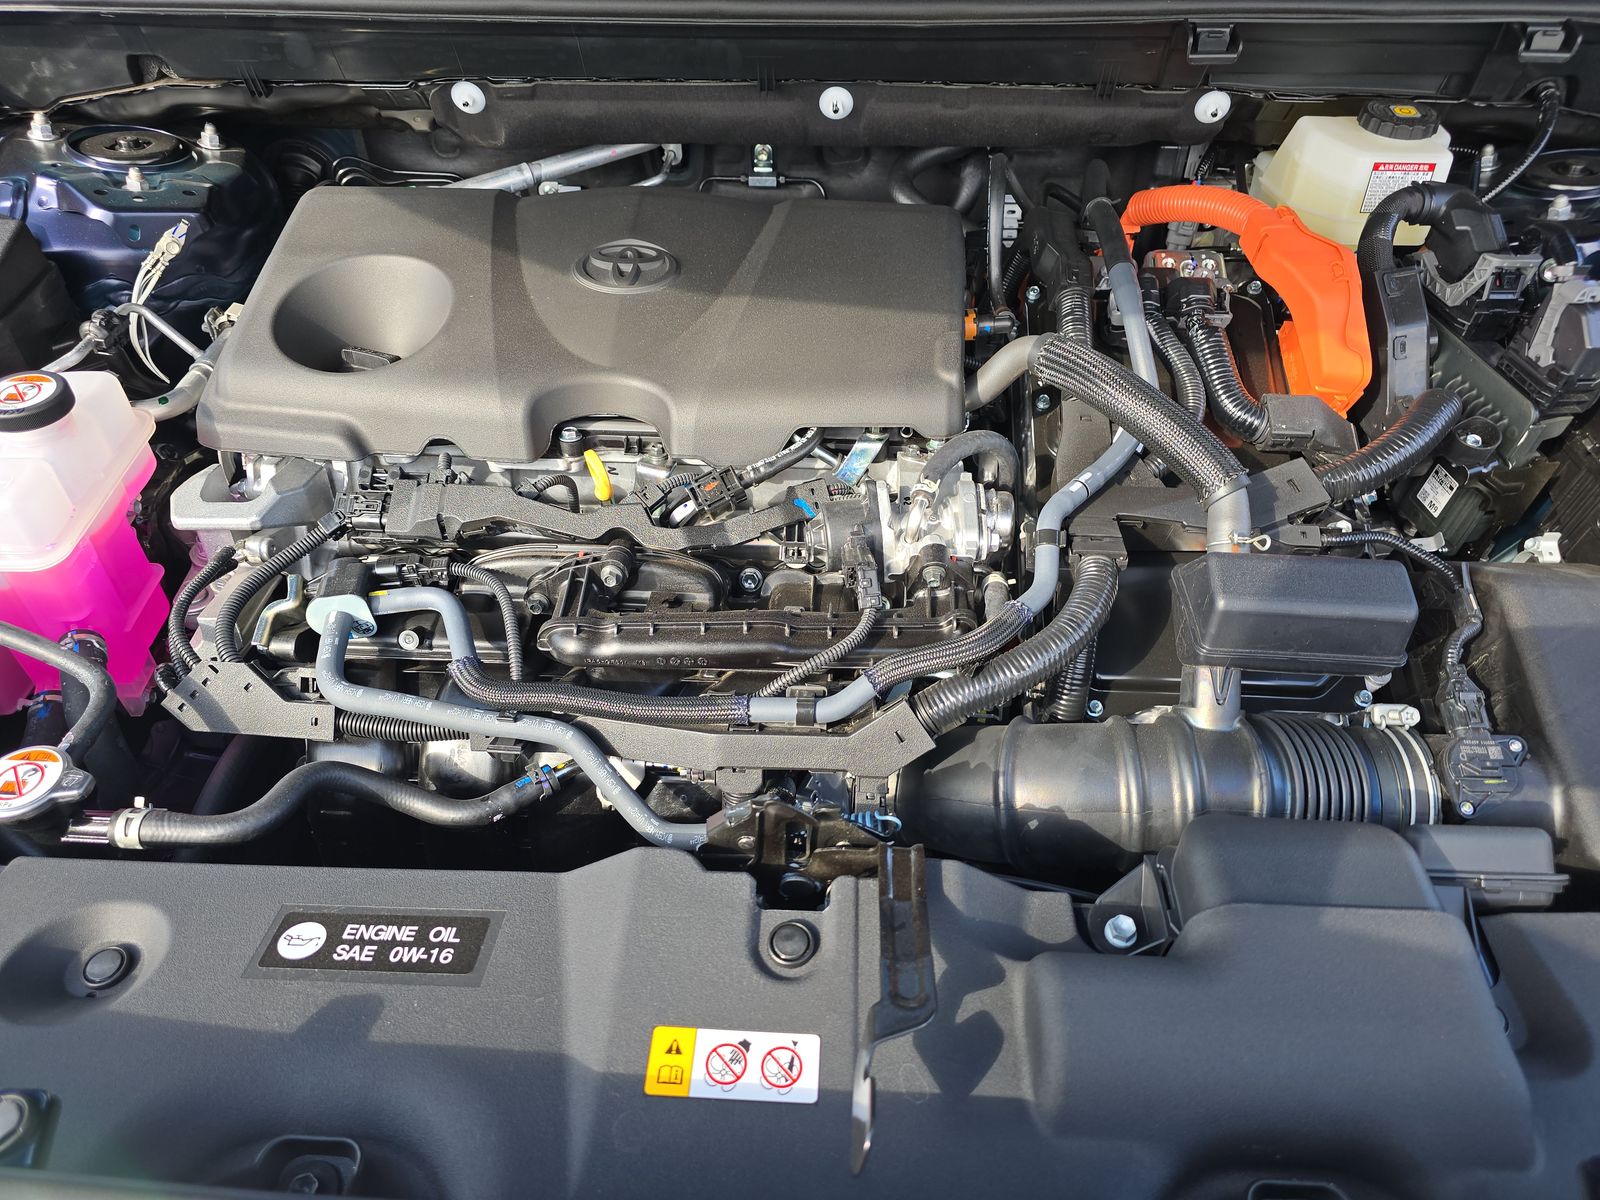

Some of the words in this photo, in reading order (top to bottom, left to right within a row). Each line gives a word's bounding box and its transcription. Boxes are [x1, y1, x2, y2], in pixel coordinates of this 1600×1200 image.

[342, 924, 418, 942] ENGINE
[429, 926, 461, 943] OIL
[332, 945, 378, 962] SAE
[388, 947, 455, 964] 0W-16
